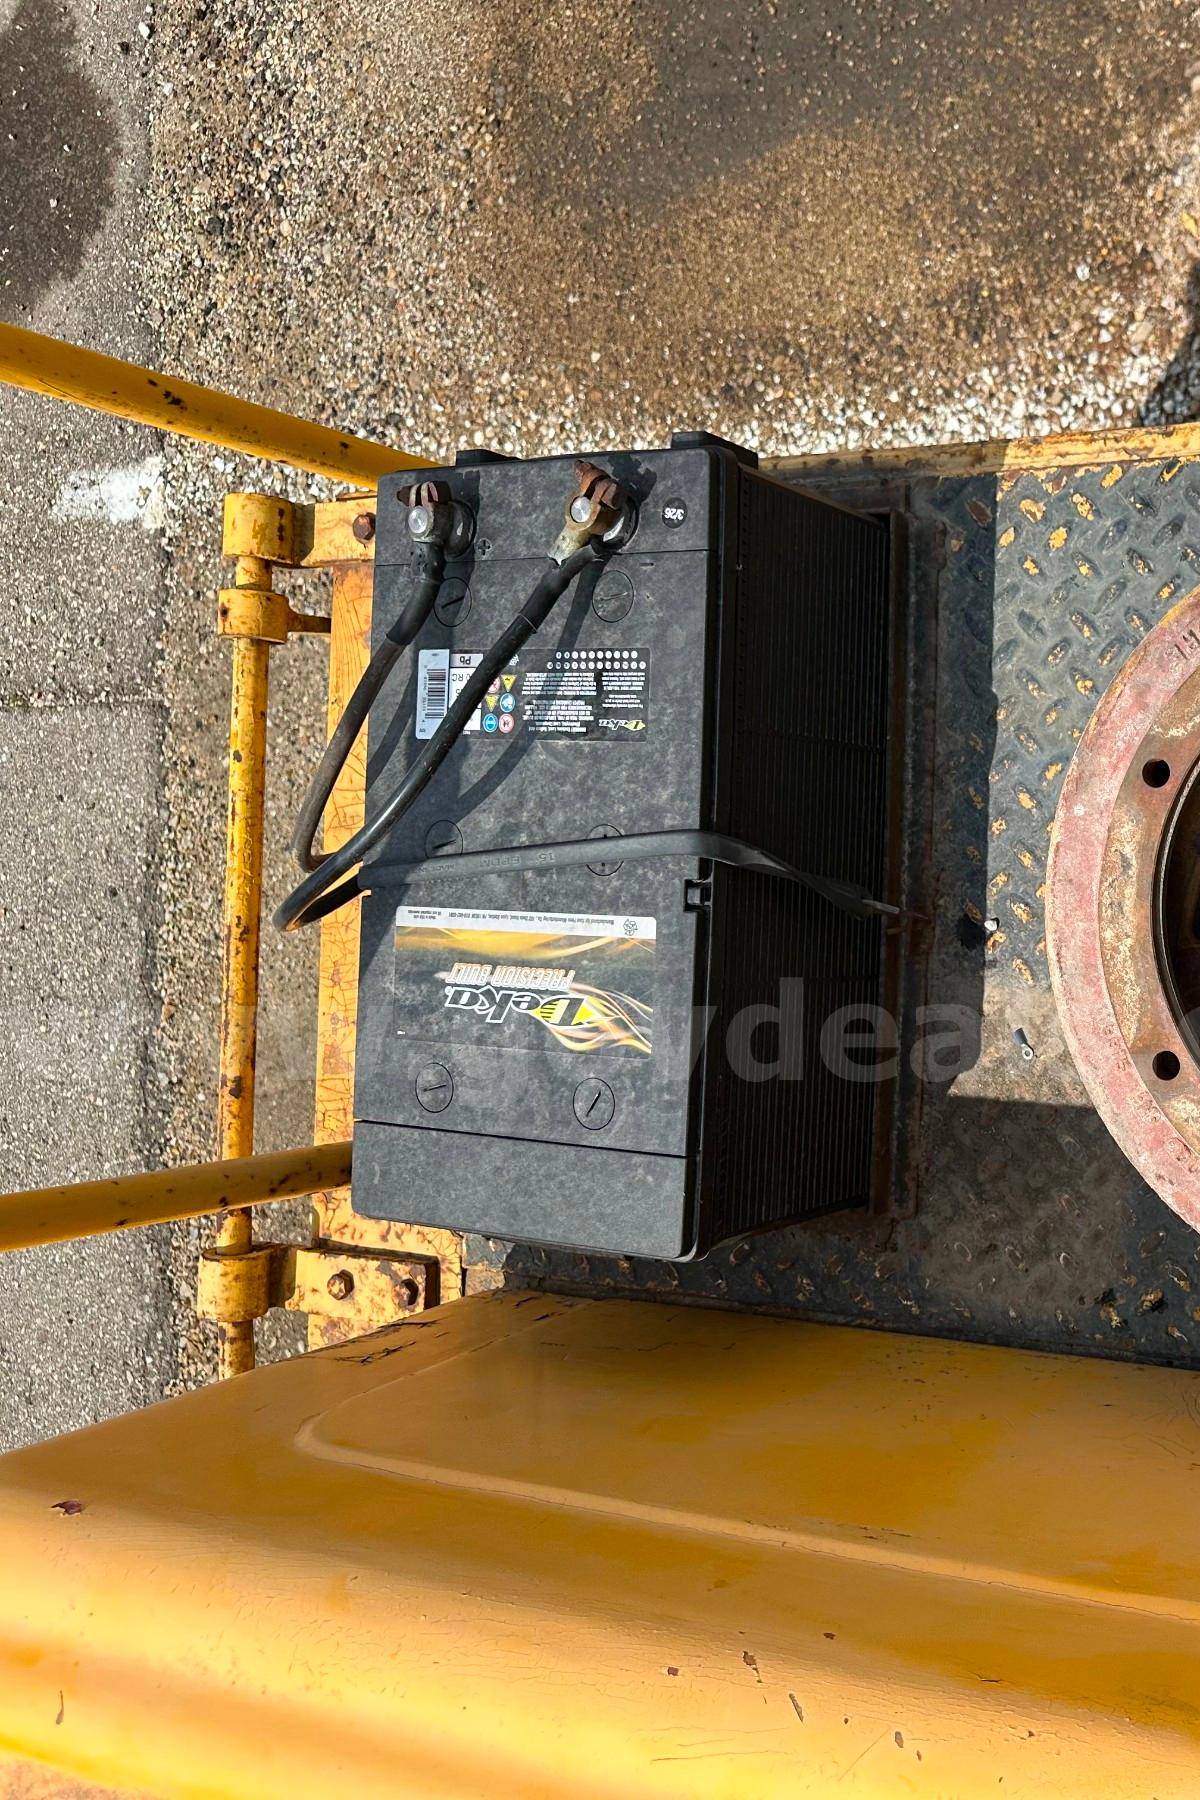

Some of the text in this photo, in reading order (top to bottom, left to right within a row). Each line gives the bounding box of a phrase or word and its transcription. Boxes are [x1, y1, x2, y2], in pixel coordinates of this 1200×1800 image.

[664, 507, 685, 520] 3/26
[459, 655, 472, 666] Pb
[599, 718, 646, 731] Deka
[444, 961, 576, 993] PRECISION BUILT
[444, 983, 588, 1029] Deka
